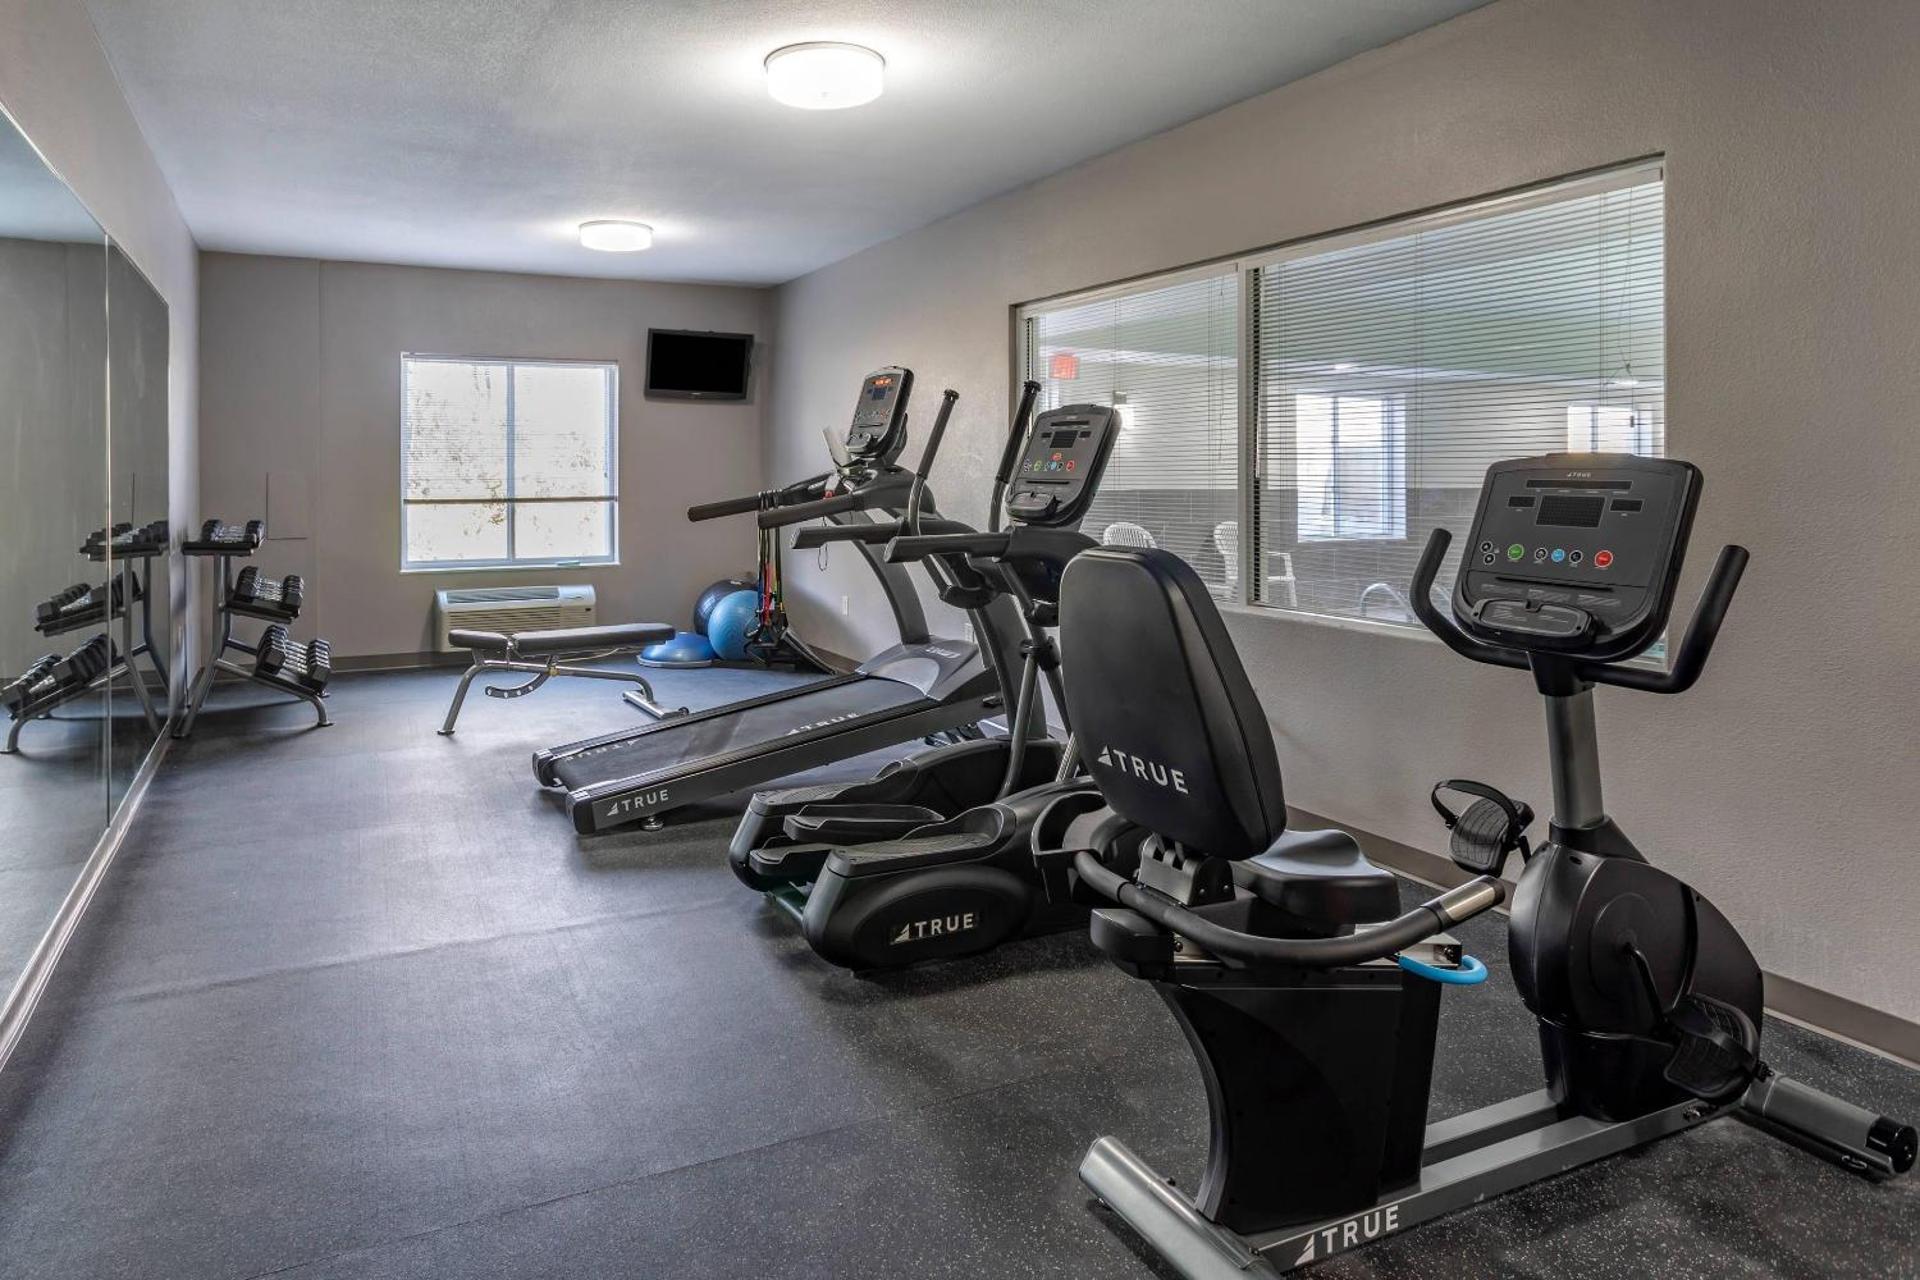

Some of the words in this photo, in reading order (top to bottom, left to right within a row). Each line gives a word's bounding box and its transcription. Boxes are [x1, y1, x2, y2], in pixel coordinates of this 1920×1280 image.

[1113, 749, 1189, 795] TRUE
[621, 789, 669, 812] TRUE
[915, 913, 974, 938] TRUE
[1322, 1205, 1399, 1254] TRUE
